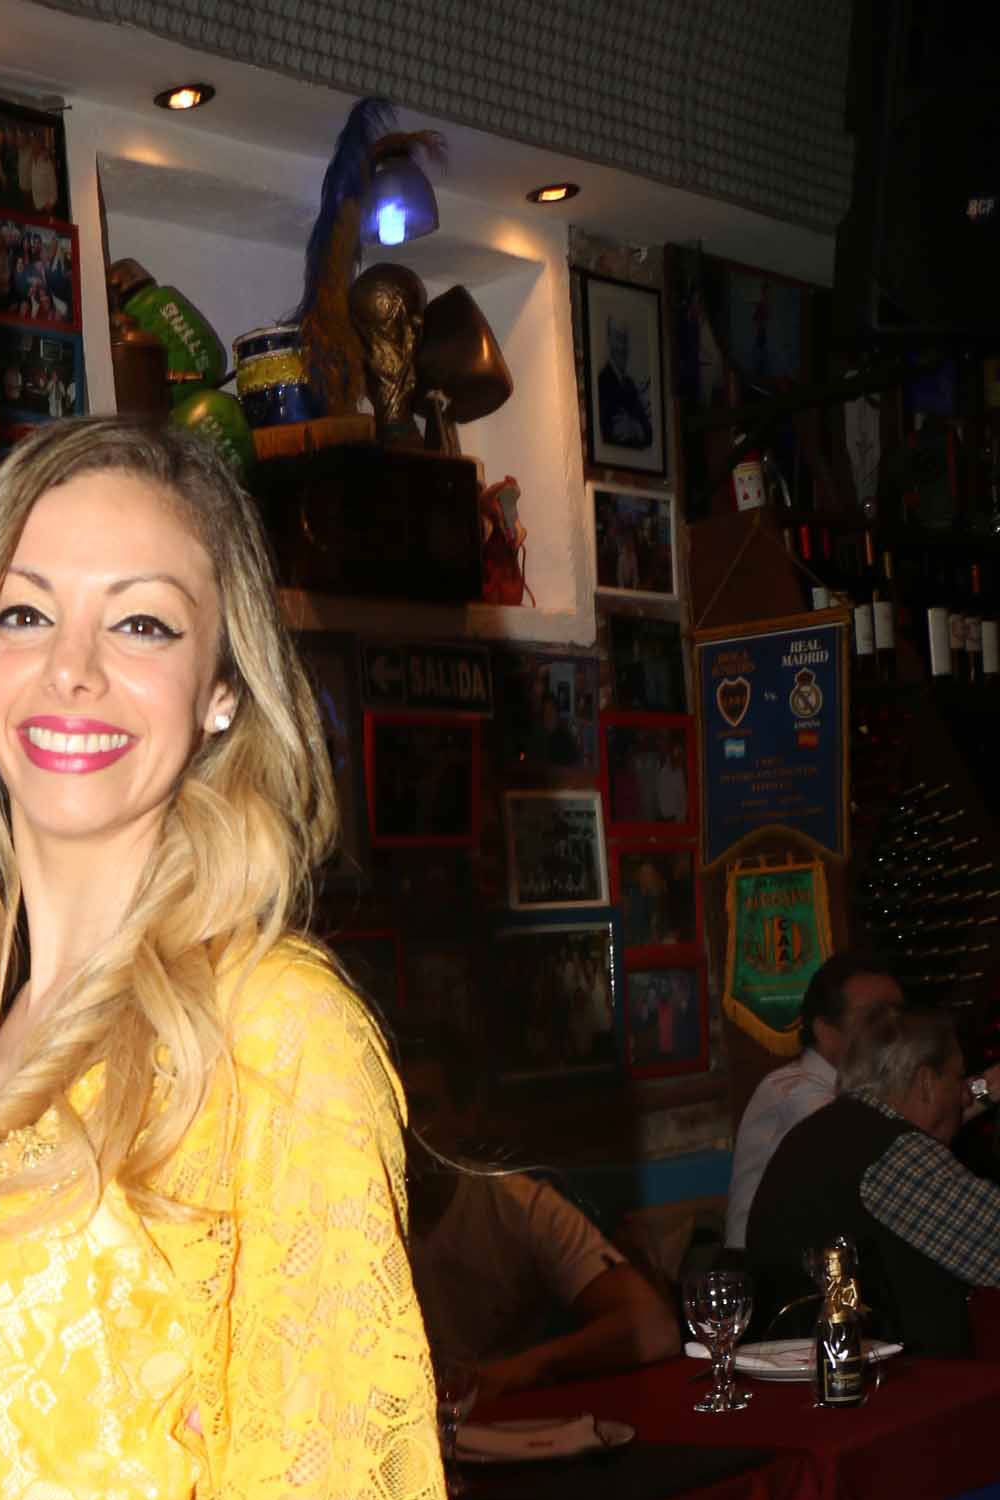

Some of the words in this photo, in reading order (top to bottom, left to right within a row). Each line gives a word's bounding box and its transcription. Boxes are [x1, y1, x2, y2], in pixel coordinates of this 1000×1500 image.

[790, 639, 822, 653] REAL
[781, 650, 830, 668] MADRID
[407, 656, 488, 702] SALIDA
